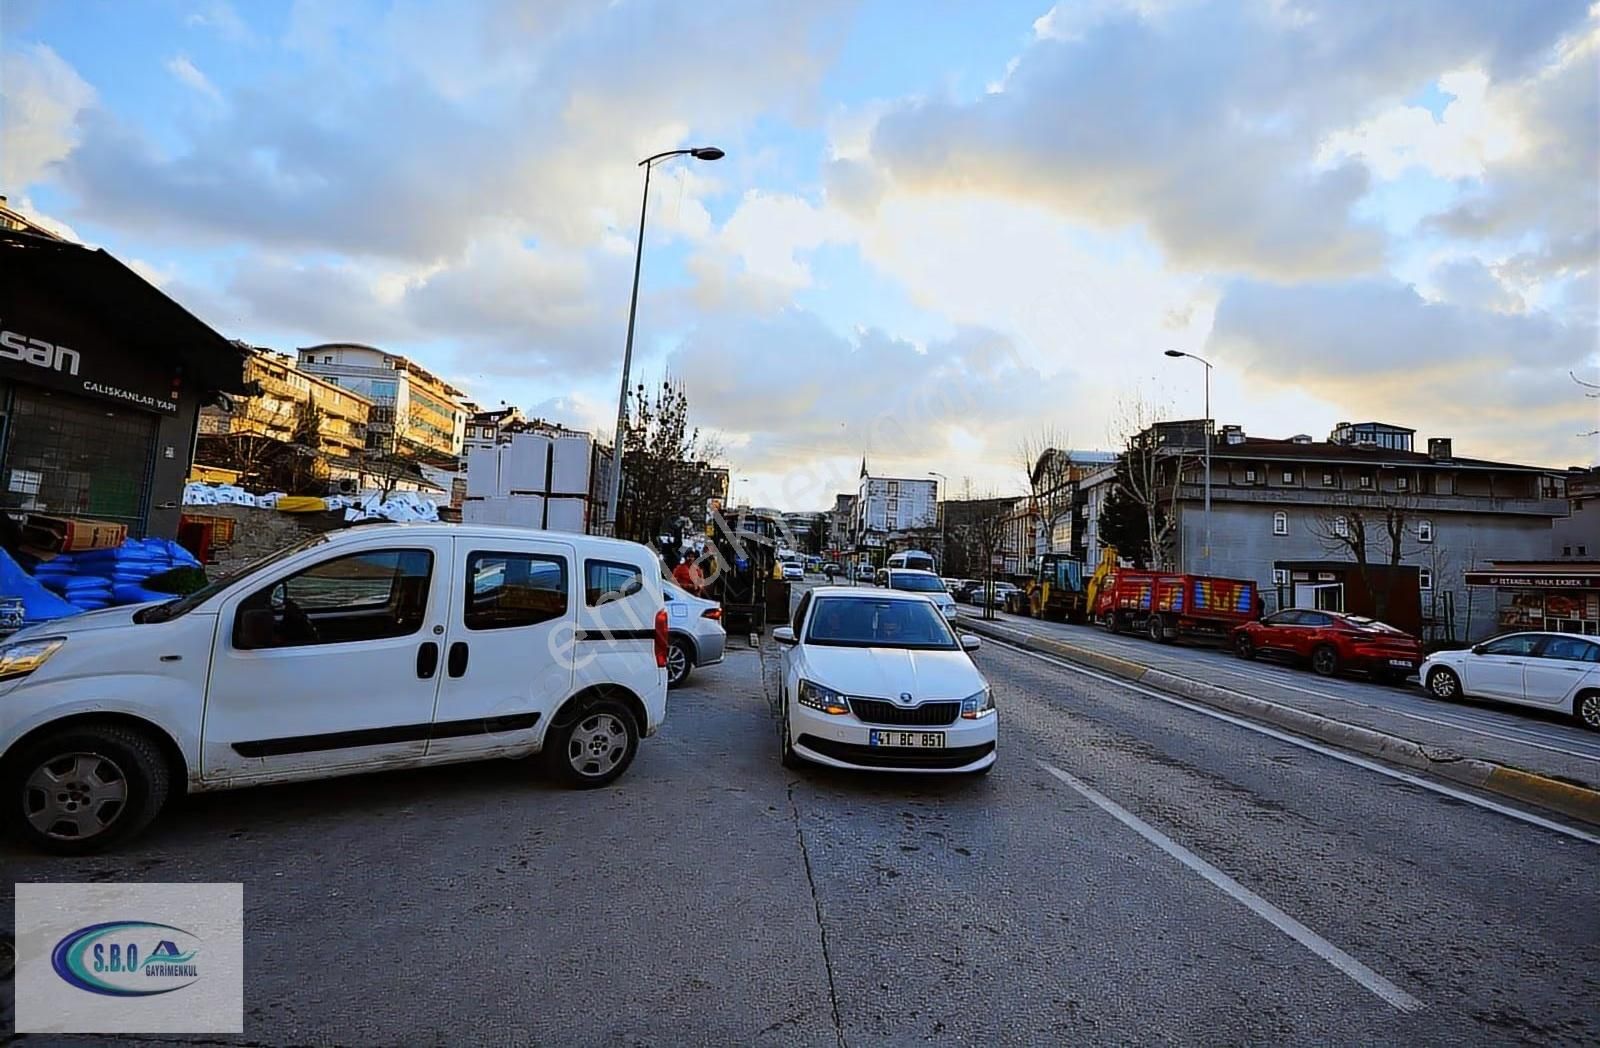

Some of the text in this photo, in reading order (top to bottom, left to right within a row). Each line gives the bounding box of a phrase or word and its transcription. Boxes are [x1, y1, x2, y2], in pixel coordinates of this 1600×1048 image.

[0, 331, 80, 375] san
[878, 732, 943, 747] 41 BC 851
